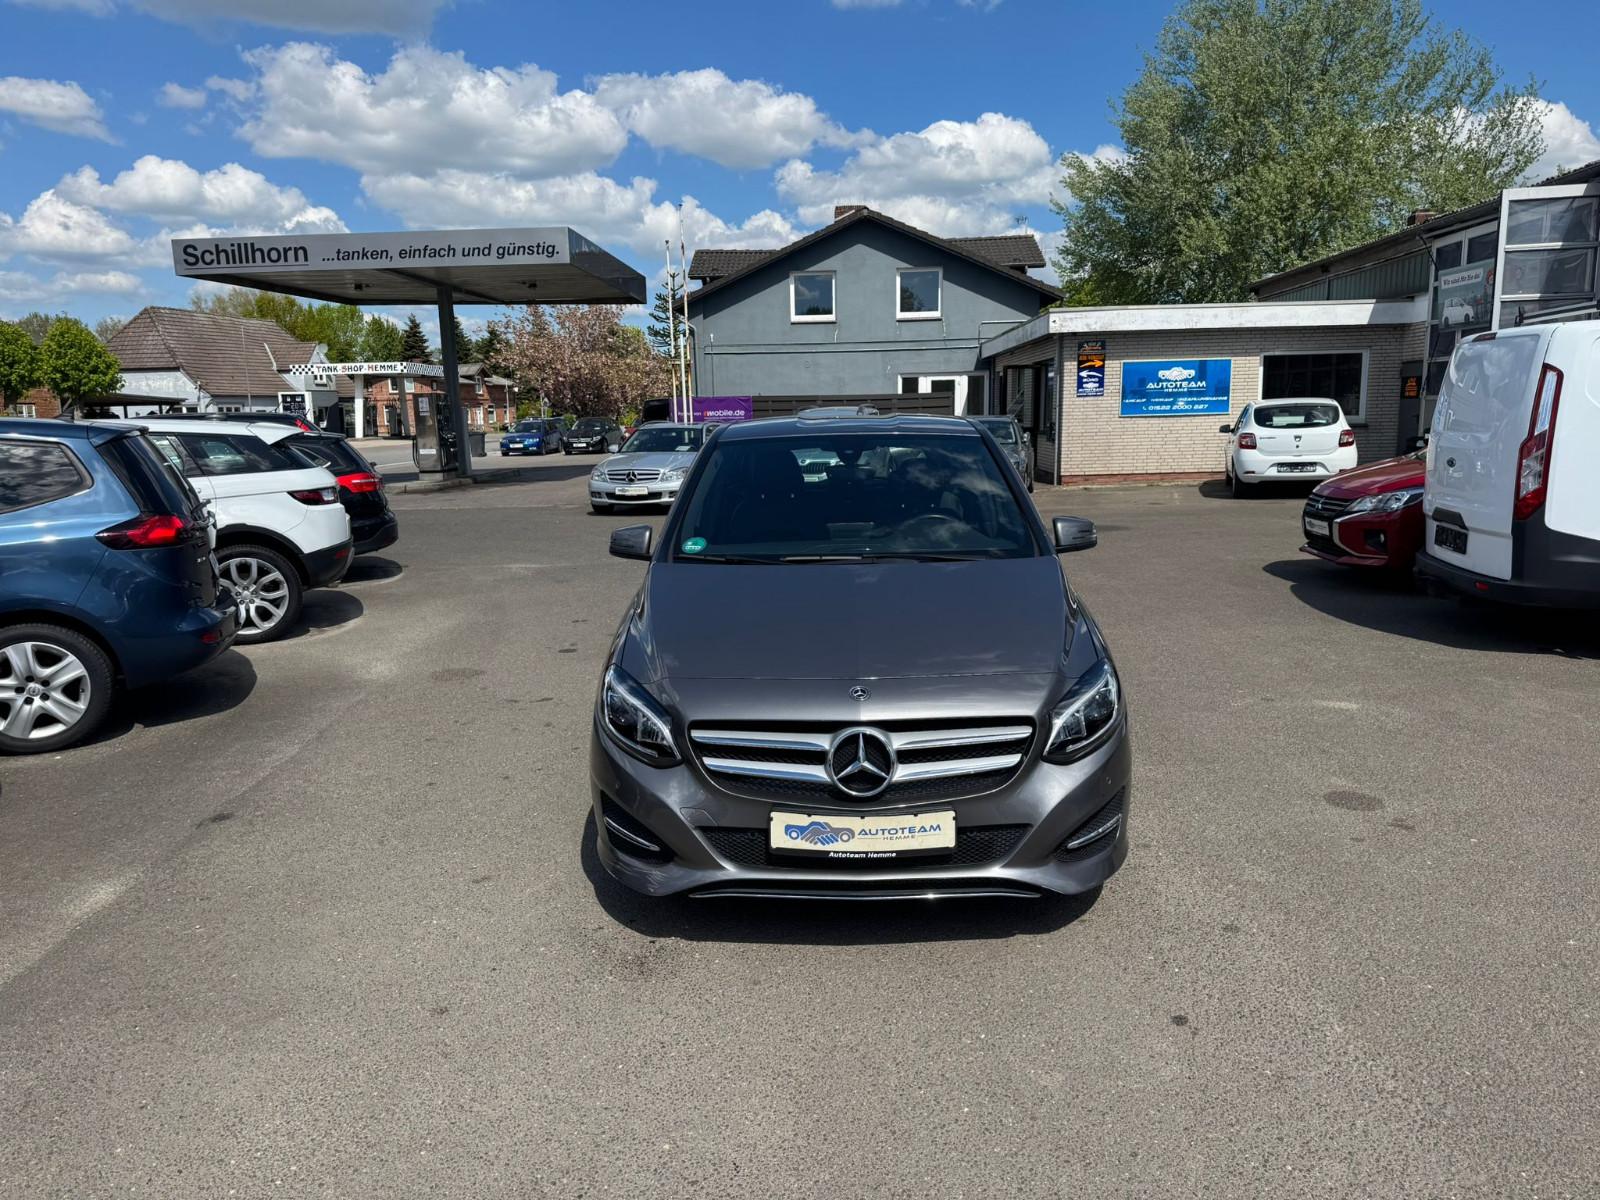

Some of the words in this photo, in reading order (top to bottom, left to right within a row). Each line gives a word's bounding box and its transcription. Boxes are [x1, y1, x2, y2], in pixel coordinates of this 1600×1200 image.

[182, 242, 309, 267] Schillhorn
[322, 247, 394, 262] ...tanken,
[399, 244, 456, 259] einfach
[461, 243, 492, 258] und
[496, 241, 560, 260] günstig.
[1146, 381, 1207, 389] AUTOTEAM
[704, 409, 746, 417] mobile.de
[857, 823, 942, 836] AUTOTEAM
